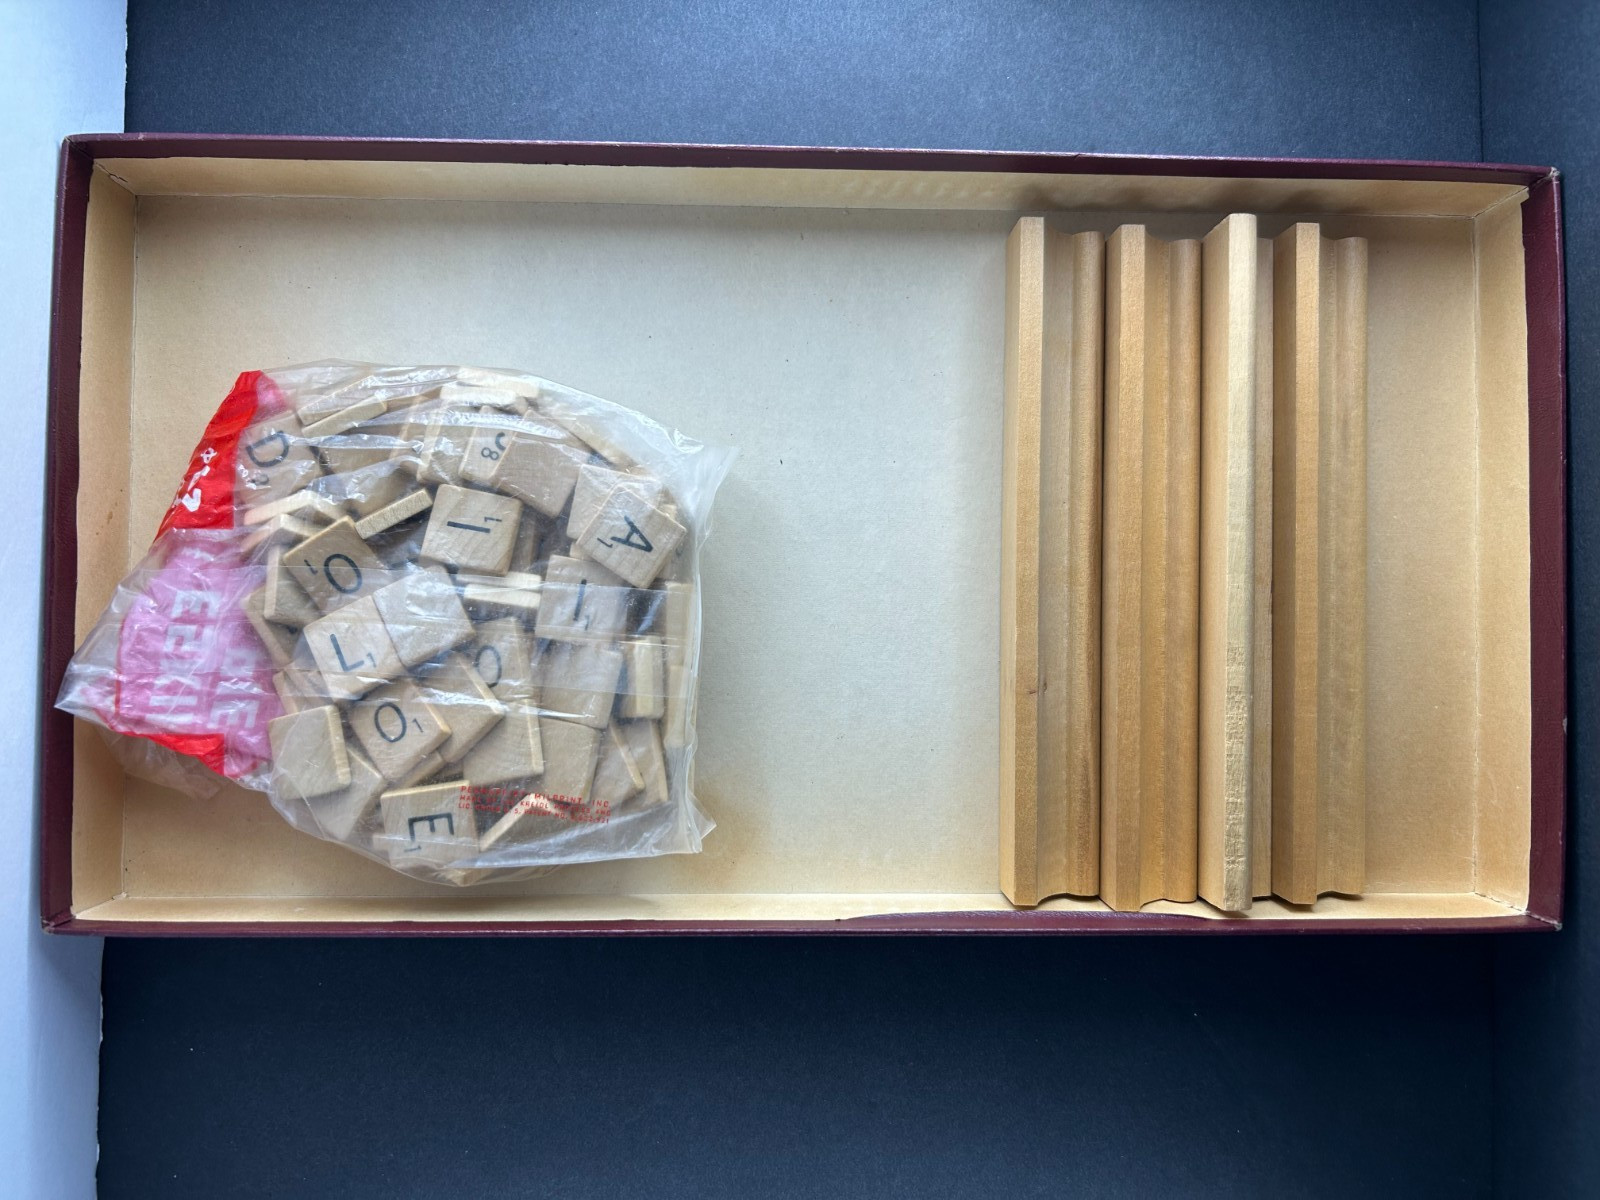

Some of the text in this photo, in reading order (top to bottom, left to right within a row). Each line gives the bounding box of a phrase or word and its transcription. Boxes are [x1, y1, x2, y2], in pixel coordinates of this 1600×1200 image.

[246, 430, 290, 468] D
[610, 515, 654, 553] A
[323, 553, 363, 594] O
[330, 633, 364, 673] L
[374, 701, 407, 743] O
[408, 812, 455, 842] E
